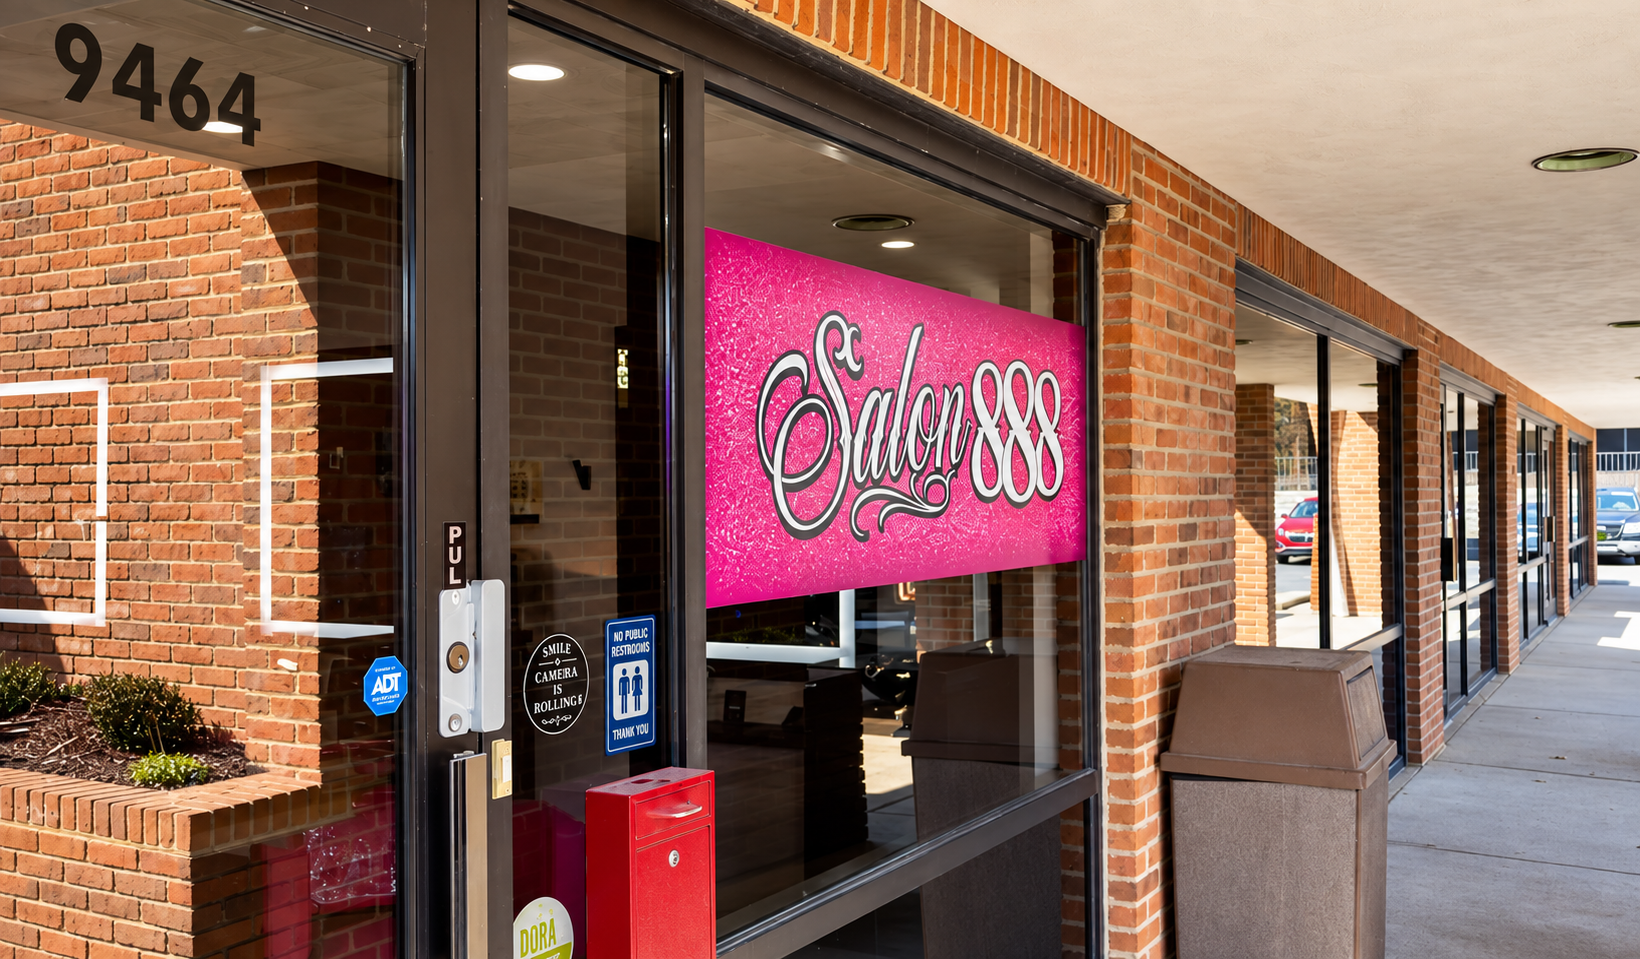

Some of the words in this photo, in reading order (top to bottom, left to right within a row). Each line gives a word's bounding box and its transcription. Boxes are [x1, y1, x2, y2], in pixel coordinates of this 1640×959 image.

[55, 22, 261, 147] 9464
[755, 310, 972, 542] Salon
[969, 359, 1066, 508] 888
[449, 525, 462, 585] PUL
[613, 630, 623, 642] NO
[625, 627, 648, 641] PUBLIC
[542, 642, 572, 658] SMILE
[611, 641, 651, 658] RESTROOMS
[370, 671, 402, 696] ADT
[553, 683, 563, 696] IS
[612, 725, 635, 741] THANK
[635, 722, 649, 736] YOU
[519, 917, 557, 959] DORA
